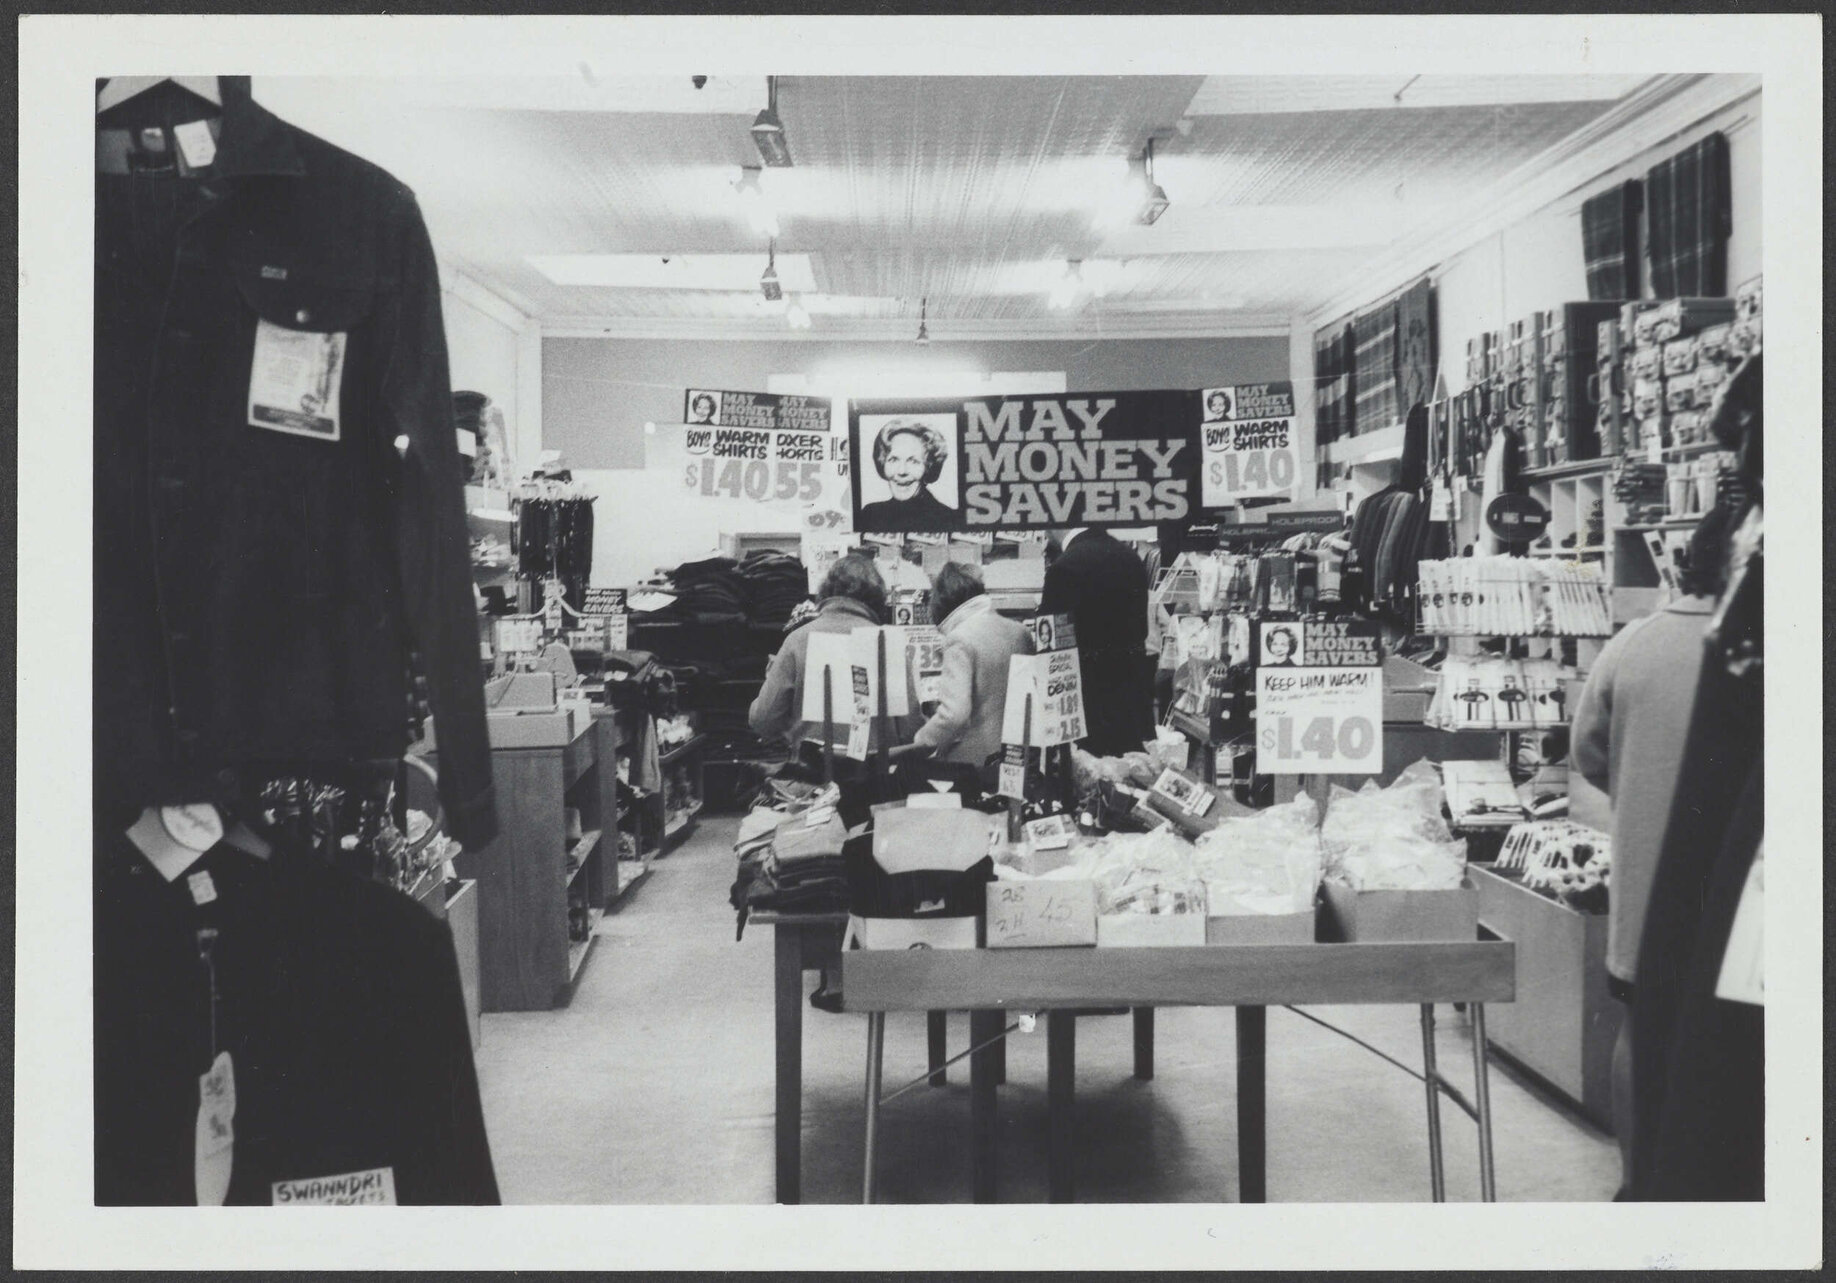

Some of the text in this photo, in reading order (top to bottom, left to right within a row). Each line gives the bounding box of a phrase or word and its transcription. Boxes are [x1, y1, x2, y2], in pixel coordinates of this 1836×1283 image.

[1237, 385, 1268, 397] MAY
[723, 392, 756, 406] MAY
[1237, 394, 1290, 408] MONEY
[722, 404, 775, 417] MONEY
[1237, 404, 1292, 418] SAVERS
[721, 415, 775, 428] SAVERS
[964, 399, 1116, 442] MAY
[1234, 420, 1289, 437] WARM
[716, 430, 769, 445] WARM
[1233, 433, 1289, 451] SHIRTS
[713, 442, 768, 460] SHIRTS
[964, 439, 1187, 482] MONEY
[1210, 449, 1295, 492] $1.40
[685, 458, 769, 500] $1.40
[965, 480, 1190, 525] SAVERS
[1271, 515, 1340, 527] HOLEPROOF
[585, 595, 622, 603] MONEY
[582, 603, 624, 613] SAVERS
[1305, 623, 1349, 637] MAY
[1305, 637, 1375, 651] MONEY
[1305, 650, 1378, 665] SAVERS
[1265, 675, 1297, 691] KEEP
[1300, 674, 1325, 689] HIM
[1261, 716, 1374, 760] $1.40
[277, 1173, 382, 1202] SWANNDRI
